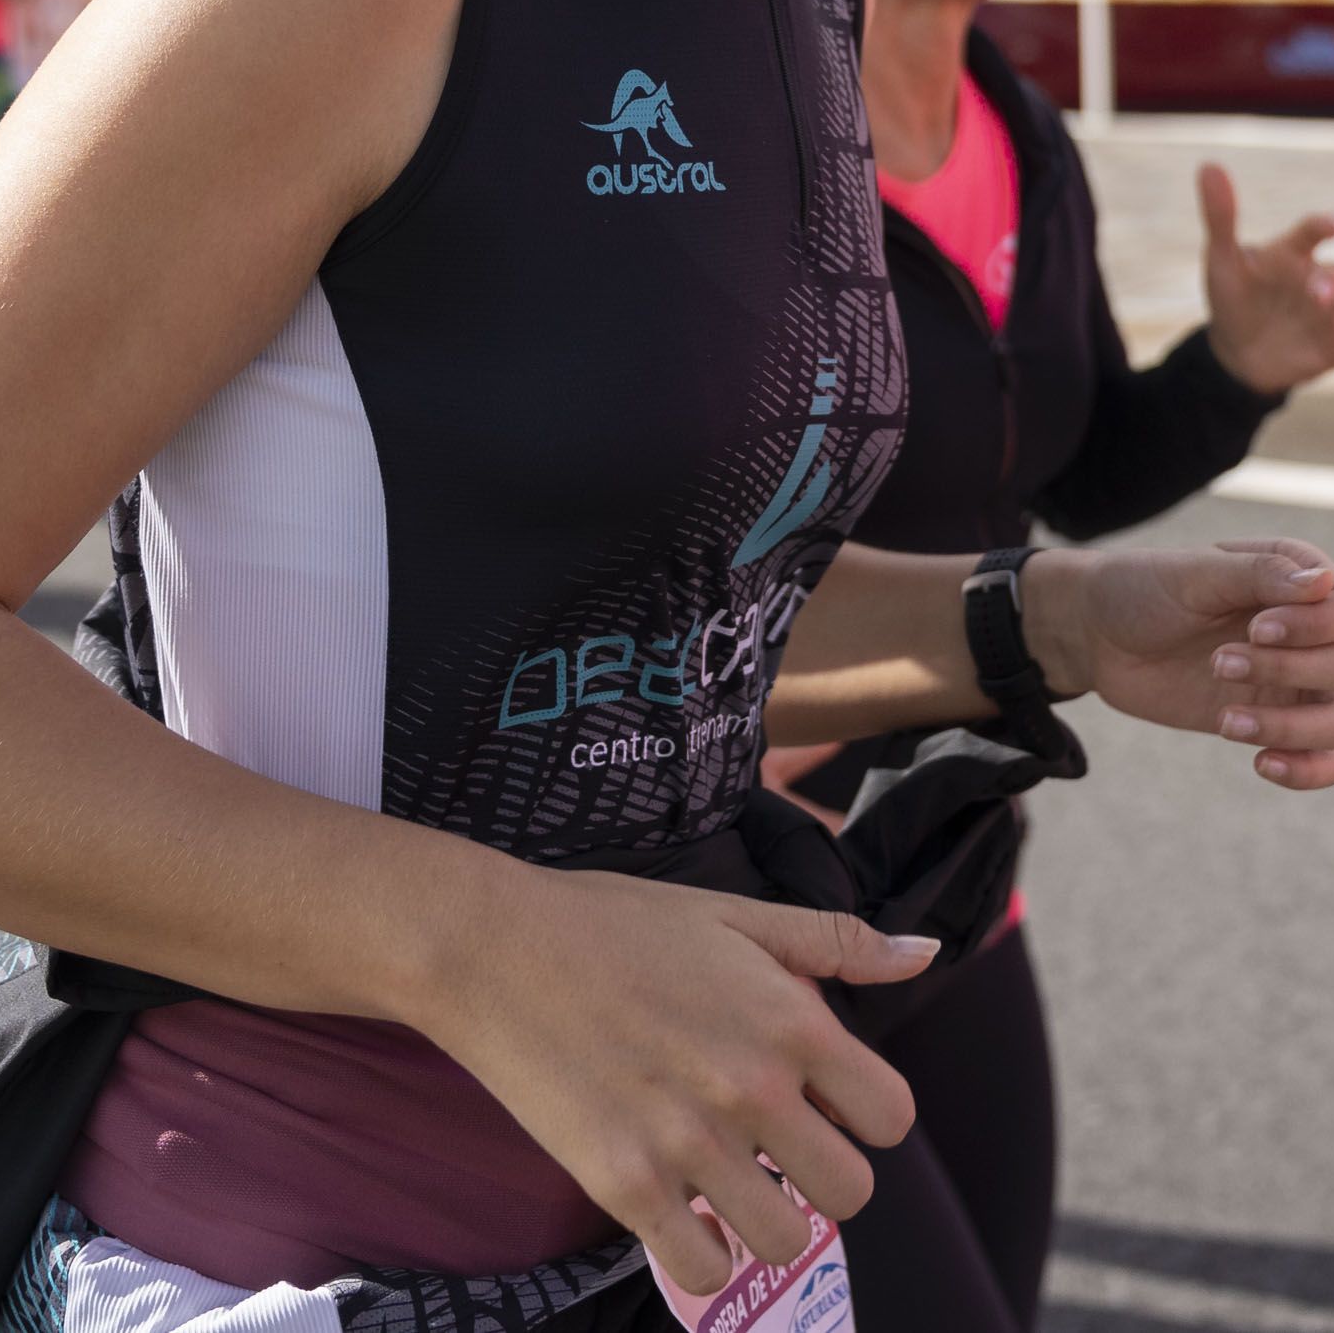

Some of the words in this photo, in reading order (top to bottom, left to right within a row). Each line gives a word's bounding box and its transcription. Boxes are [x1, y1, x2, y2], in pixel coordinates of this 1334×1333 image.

[586, 161, 727, 196] austral
[570, 728, 676, 768] centro
[748, 1269, 769, 1311] DE
